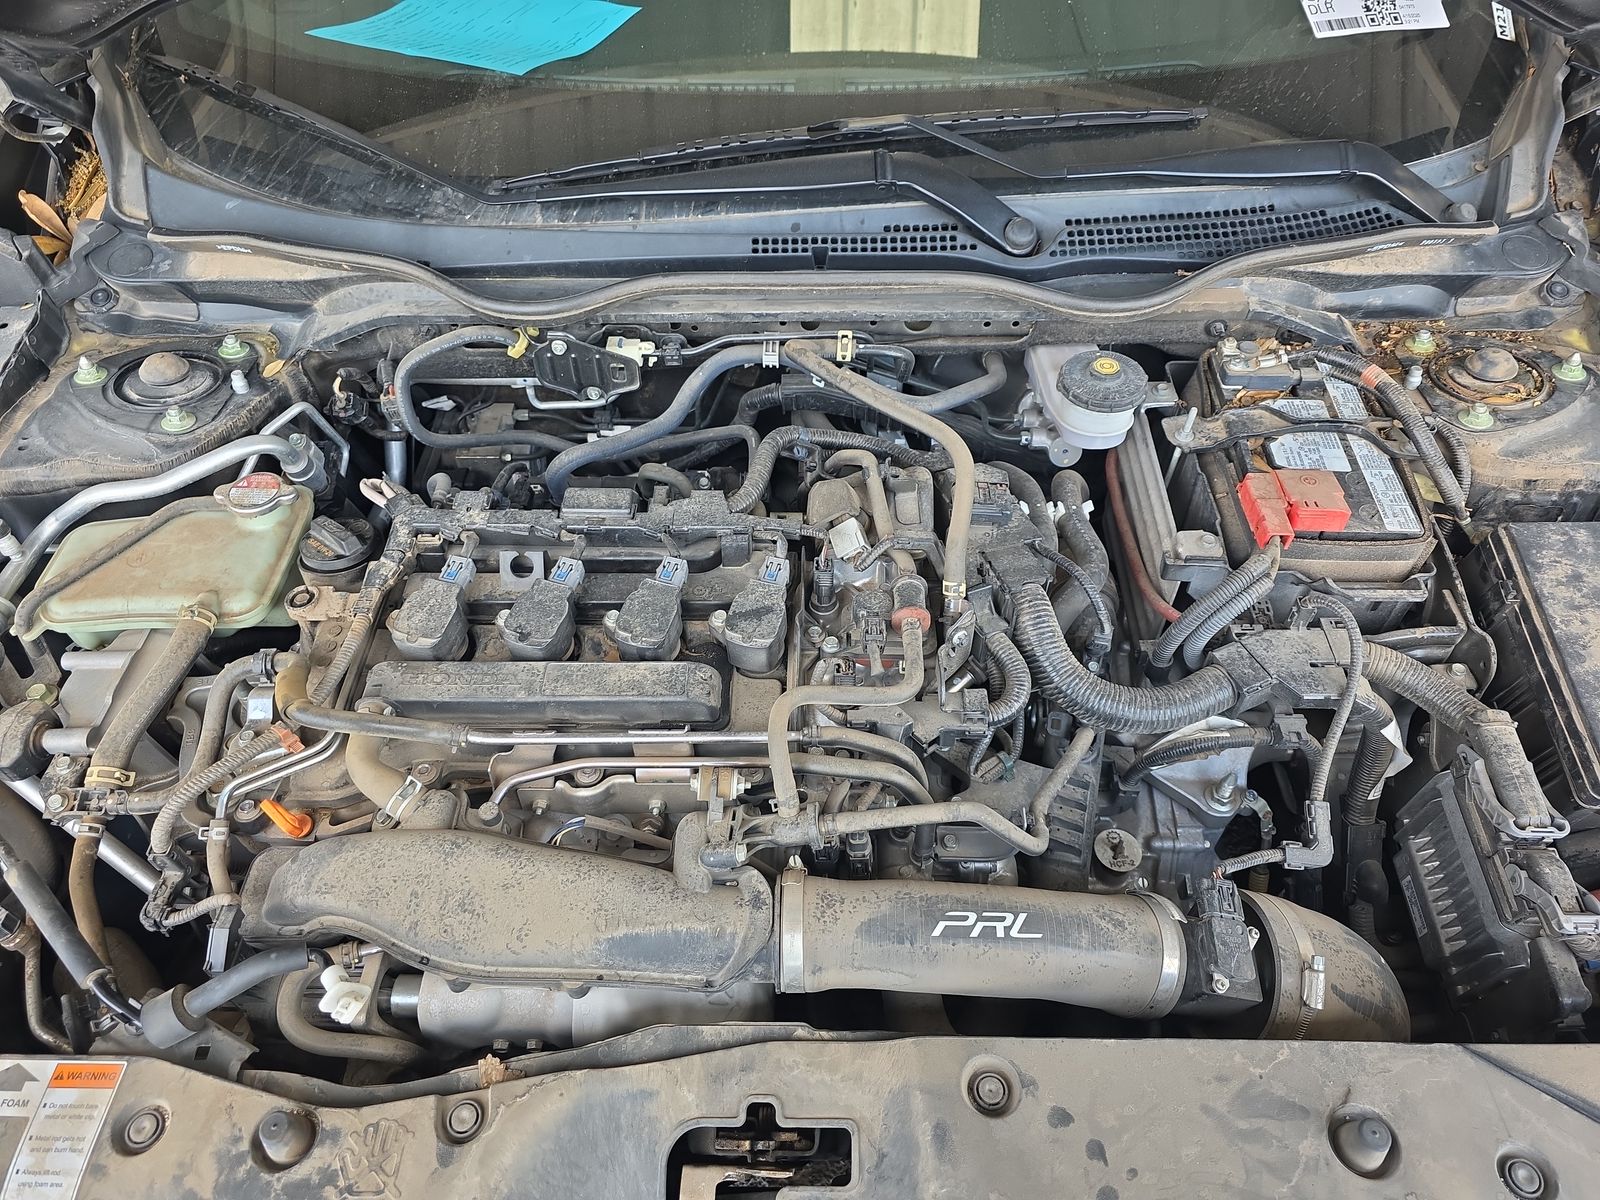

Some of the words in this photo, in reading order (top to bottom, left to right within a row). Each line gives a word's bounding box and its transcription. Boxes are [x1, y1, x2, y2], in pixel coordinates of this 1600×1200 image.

[1308, 3, 1335, 15] DLR
[1496, 7, 1509, 38] M21
[400, 672, 522, 687] HONDA
[1109, 859, 1136, 869] HCF-2
[930, 911, 1044, 939] PRL
[66, 1071, 118, 1081] WARNING
[0, 1098, 30, 1108] FOAM
[21, 1168, 42, 1177] Always
[33, 1180, 49, 1188] foam
